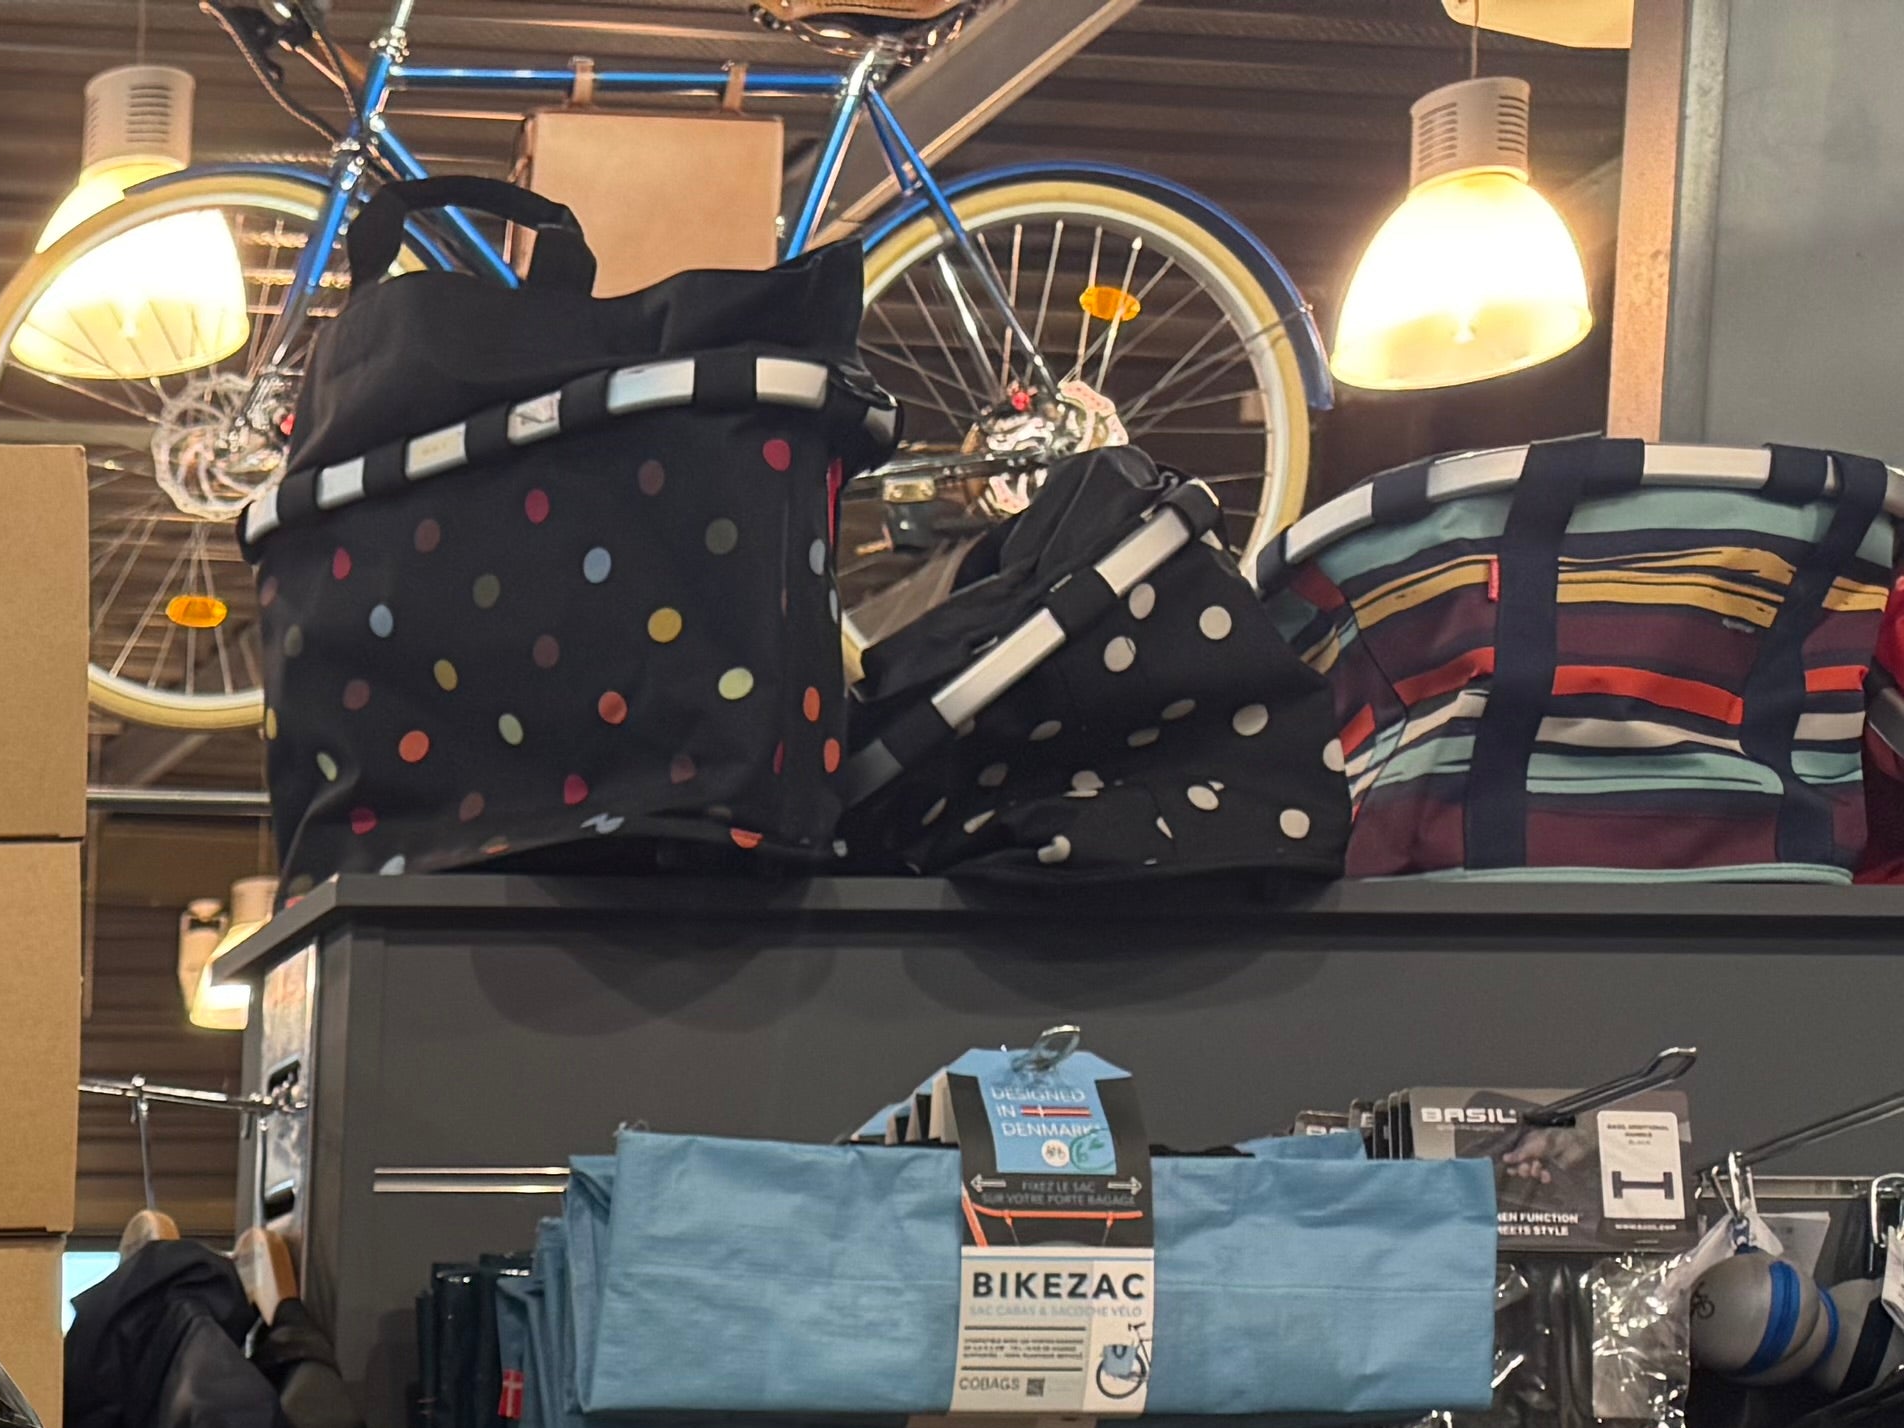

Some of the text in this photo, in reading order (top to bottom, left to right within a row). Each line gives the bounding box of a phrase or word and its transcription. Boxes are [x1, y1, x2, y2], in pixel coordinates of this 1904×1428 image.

[997, 1104, 1016, 1118] IN
[1420, 1107, 1518, 1124] BASIL
[1520, 1212, 1579, 1225] FUNCTION
[1533, 1225, 1569, 1236] STYLE
[972, 1271, 1145, 1300] BIKEZAC
[959, 1377, 1020, 1391] COBAGS
